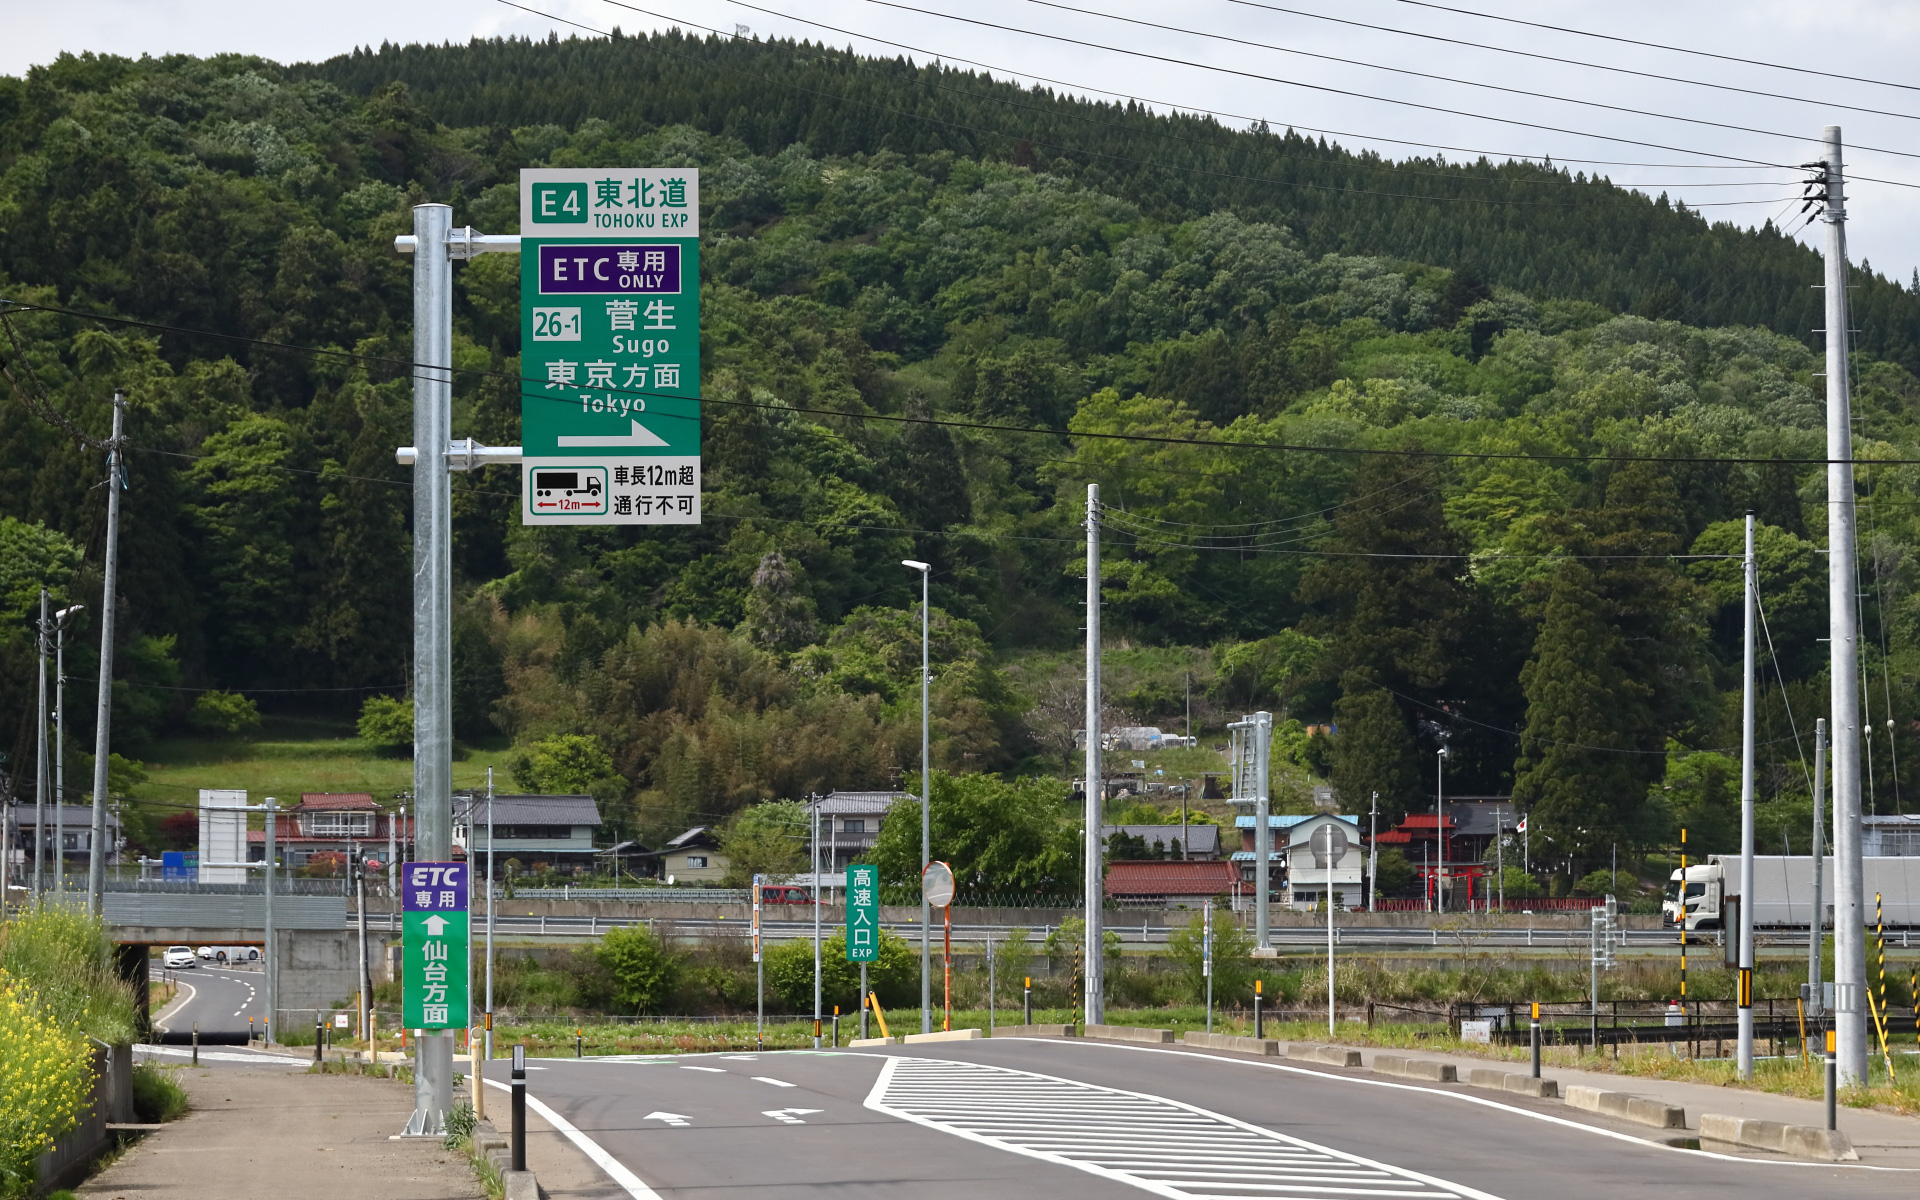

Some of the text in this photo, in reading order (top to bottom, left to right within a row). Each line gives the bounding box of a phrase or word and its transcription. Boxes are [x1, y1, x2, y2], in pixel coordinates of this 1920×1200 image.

[541, 190, 580, 216] E4
[594, 177, 688, 209] 東北道
[594, 213, 689, 228] TOHOKU EXP
[554, 258, 610, 281] ETC
[617, 250, 665, 272] 専用
[618, 274, 664, 289] ONLY
[534, 311, 579, 337] 26-1
[605, 299, 677, 331] 菅生
[612, 335, 670, 358] Sugo
[544, 358, 681, 391] 東京方面
[579, 393, 646, 417] Tokyo
[614, 465, 695, 486] 車長12m超
[558, 499, 580, 510] 12m
[614, 495, 695, 516] 通行不可
[411, 867, 460, 887] ETC
[415, 890, 456, 908] 専用
[853, 868, 872, 946] 高速入口
[852, 948, 873, 958] EXP
[421, 940, 449, 1024] 仙台方面
